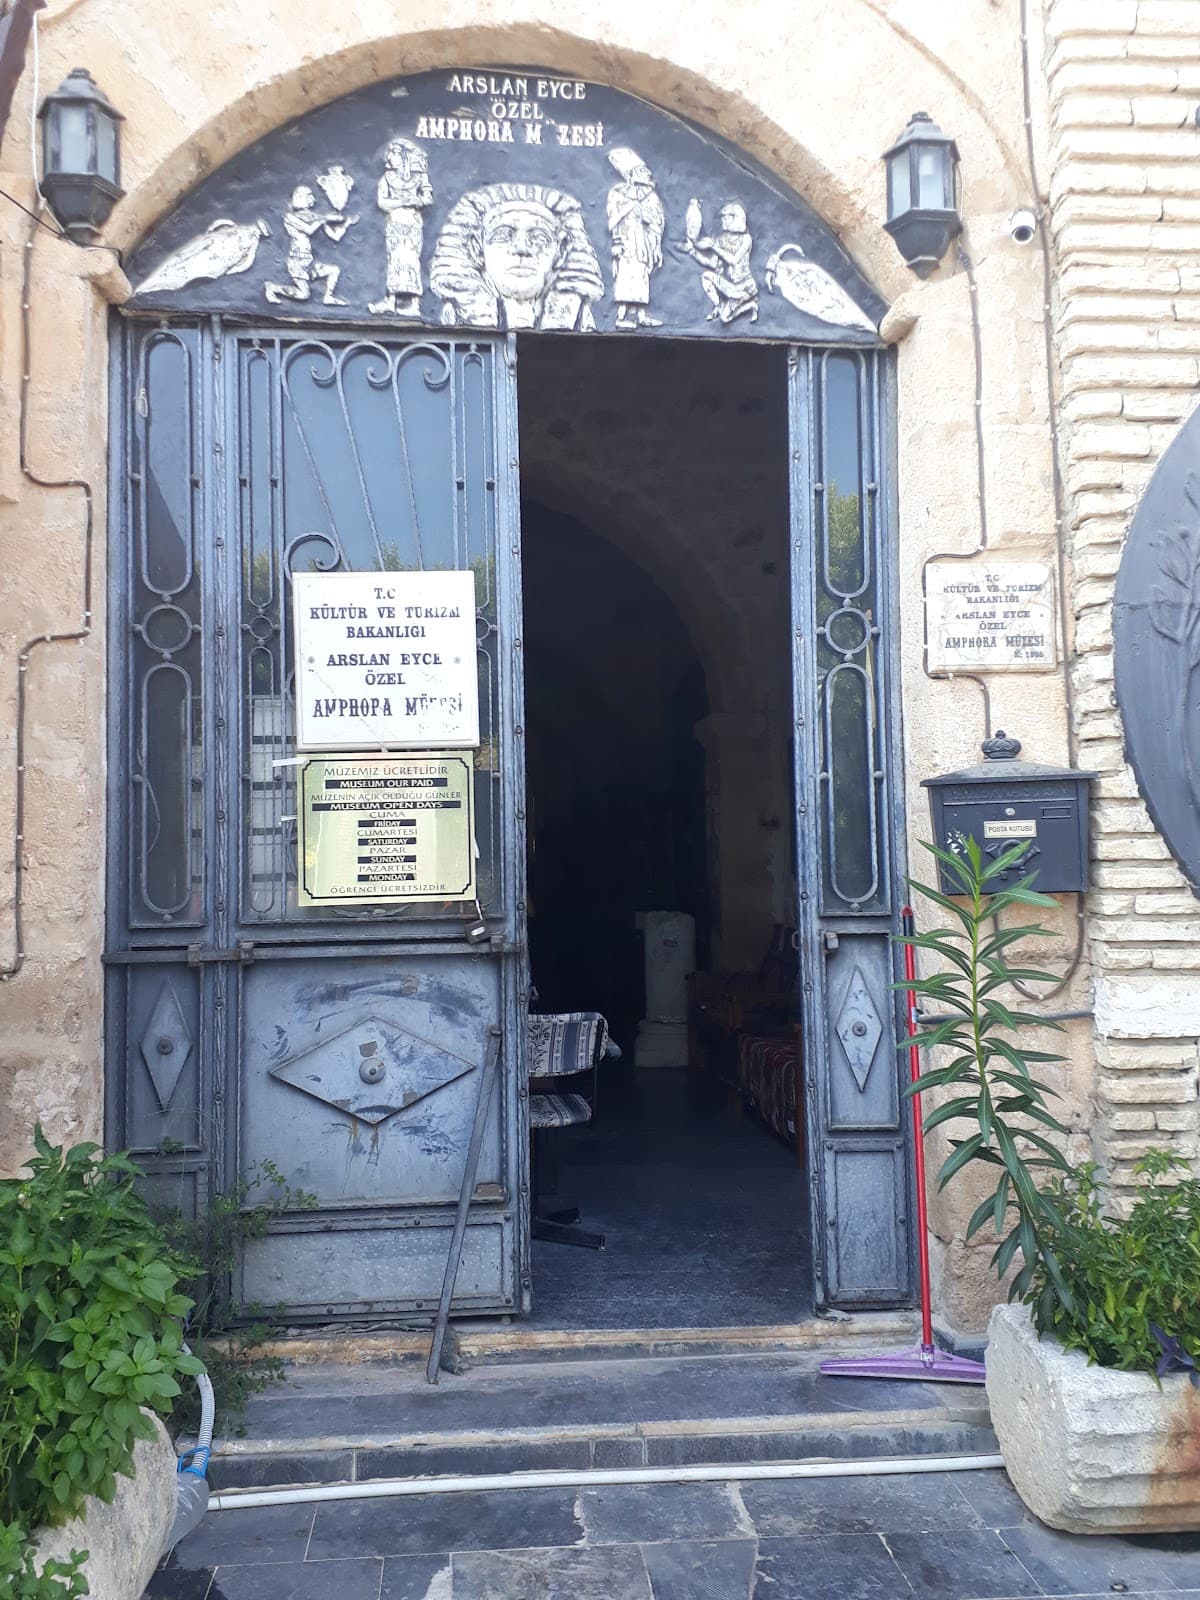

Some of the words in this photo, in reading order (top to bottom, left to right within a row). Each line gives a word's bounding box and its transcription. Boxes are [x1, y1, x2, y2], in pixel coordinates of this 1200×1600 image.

[449, 75, 528, 96] ARSLAN
[537, 80, 586, 99] EYCE
[490, 96, 544, 120] ÖZEL
[415, 117, 514, 143] AMPHORA
[377, 606, 396, 619] VE
[1003, 610, 1031, 619] EYCE
[979, 620, 1007, 630] ÖZEL
[944, 636, 998, 649] AMPHORA
[326, 653, 391, 667] ARSLAN
[400, 652, 443, 666] EYCE
[364, 669, 407, 686] ÖZEL
[339, 780, 385, 789] MUSEUM
[386, 779, 409, 788] OUR
[411, 778, 434, 787] PAID
[329, 802, 381, 811] MUSEUM
[383, 801, 414, 809] OPEN
[416, 800, 444, 809] DAYS
[368, 811, 407, 819] CUMA
[367, 838, 409, 846] SATURDAY
[369, 846, 407, 855] PAZAR
[370, 856, 406, 864] SUNDAY
[368, 873, 408, 882] MONDAY
